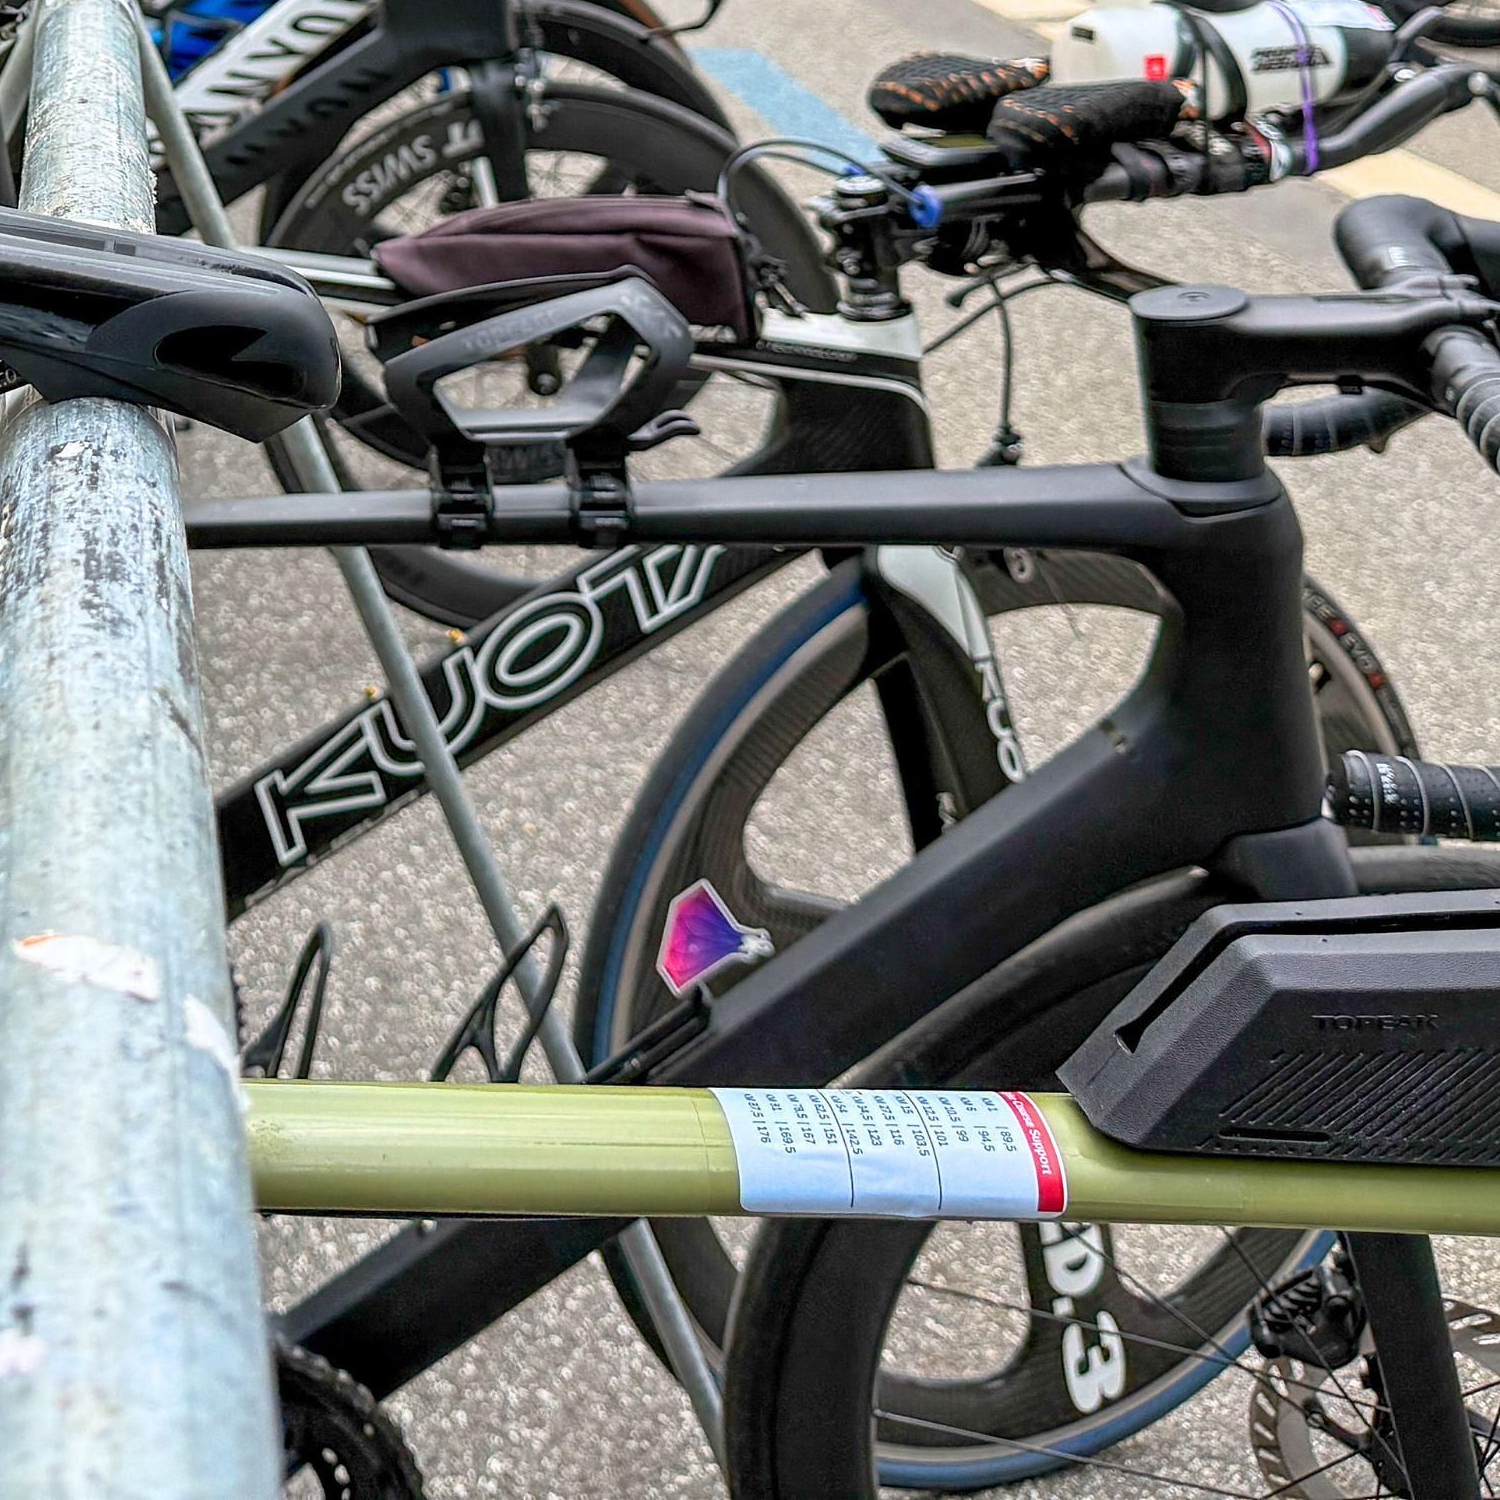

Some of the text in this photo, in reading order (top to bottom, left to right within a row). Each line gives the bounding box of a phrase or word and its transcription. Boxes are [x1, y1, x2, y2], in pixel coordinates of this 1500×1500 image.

[341, 134, 437, 215] SWISS
[975, 659, 1027, 783] KUO
[1029, 1128, 1053, 1176] Support
